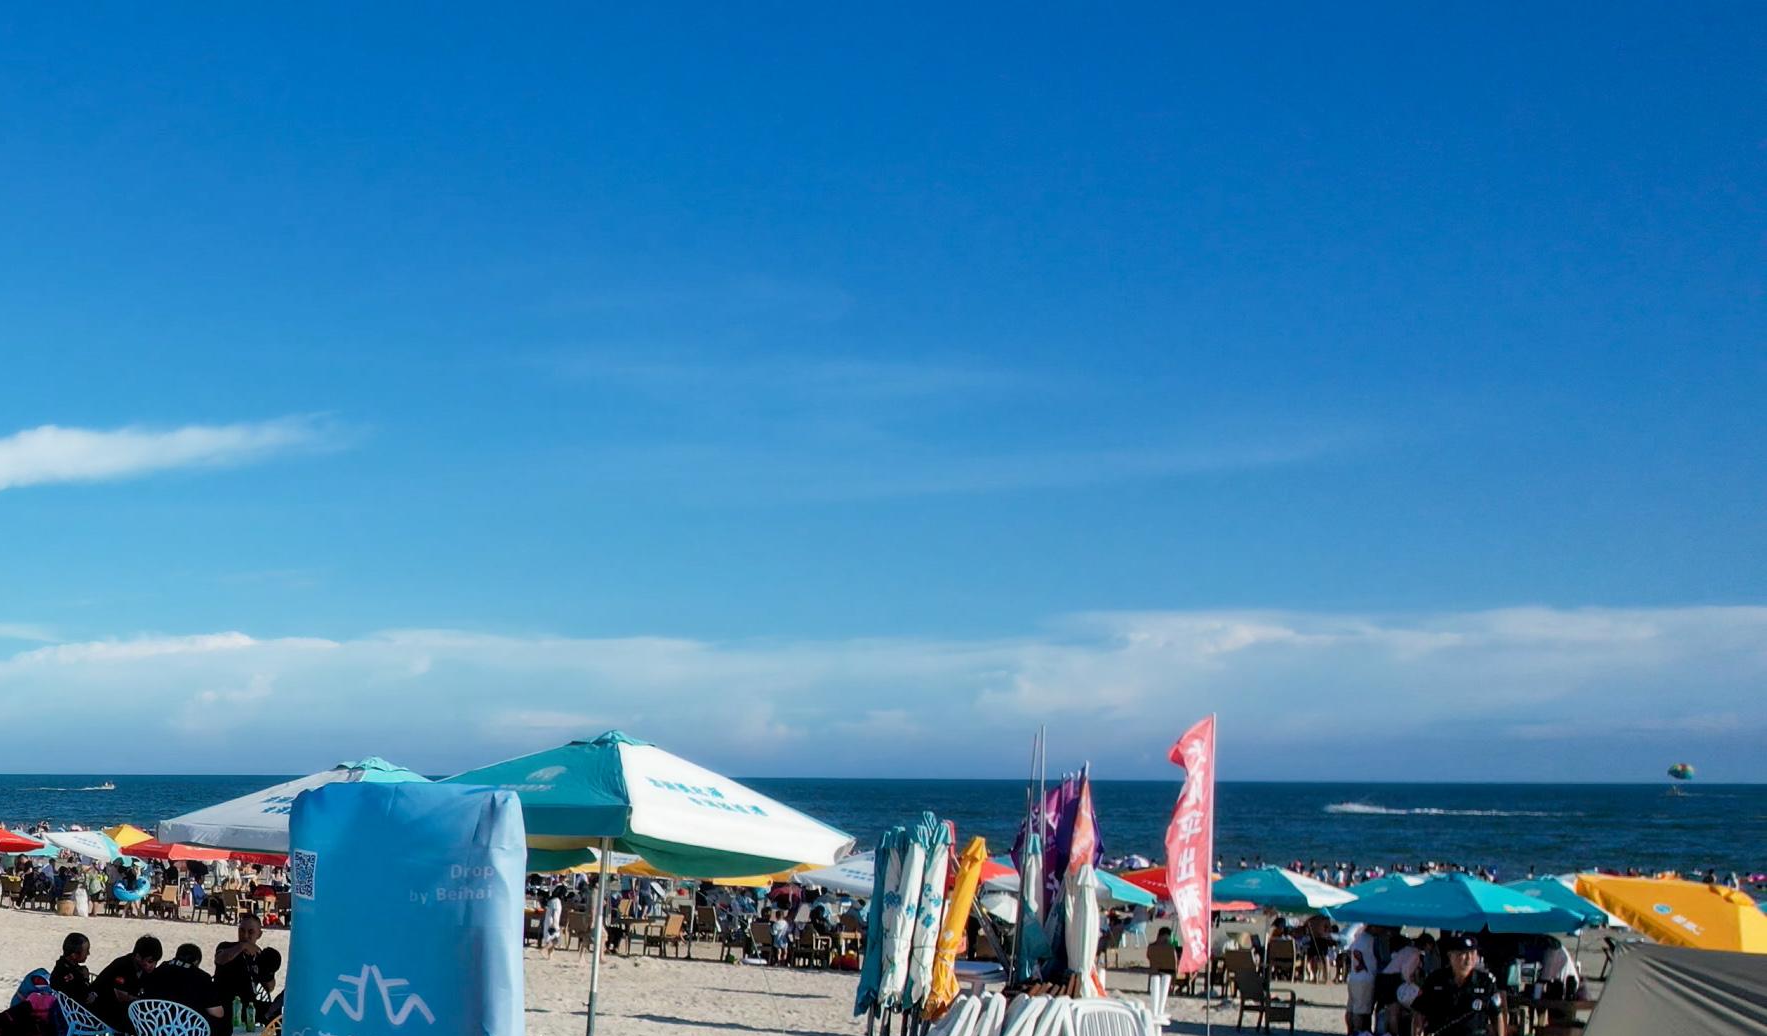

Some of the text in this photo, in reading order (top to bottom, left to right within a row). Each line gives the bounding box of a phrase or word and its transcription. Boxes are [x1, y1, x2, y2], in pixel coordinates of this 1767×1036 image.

[450, 864, 495, 880] Drop
[409, 884, 492, 905] by Beihai
